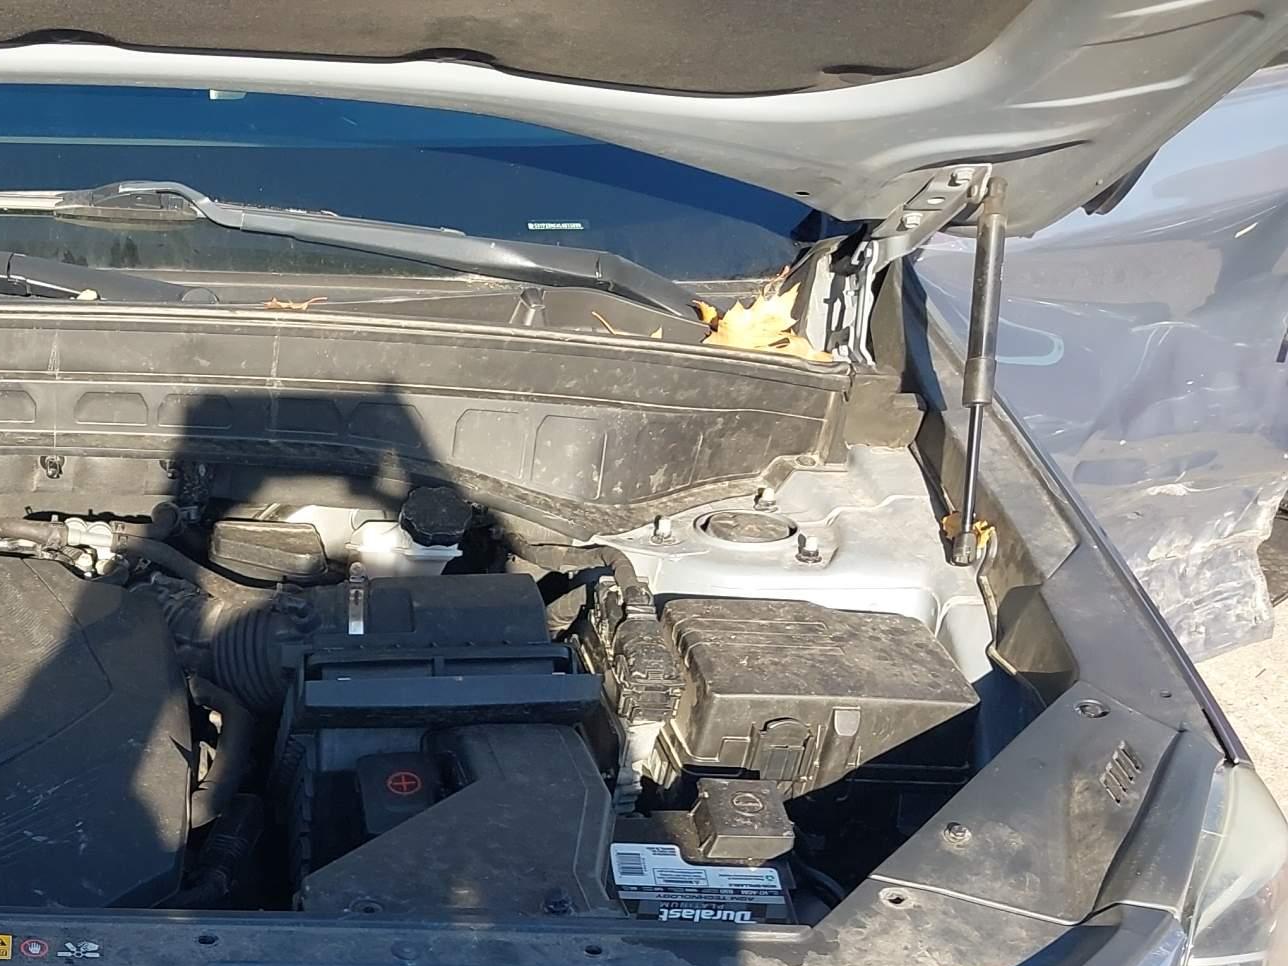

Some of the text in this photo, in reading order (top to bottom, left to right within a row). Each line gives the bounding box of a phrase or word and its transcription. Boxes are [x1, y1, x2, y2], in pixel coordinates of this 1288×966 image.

[655, 893, 728, 901] TECHNOLOGY
[659, 901, 725, 910] PLATINUM
[657, 908, 757, 924] Duralast
